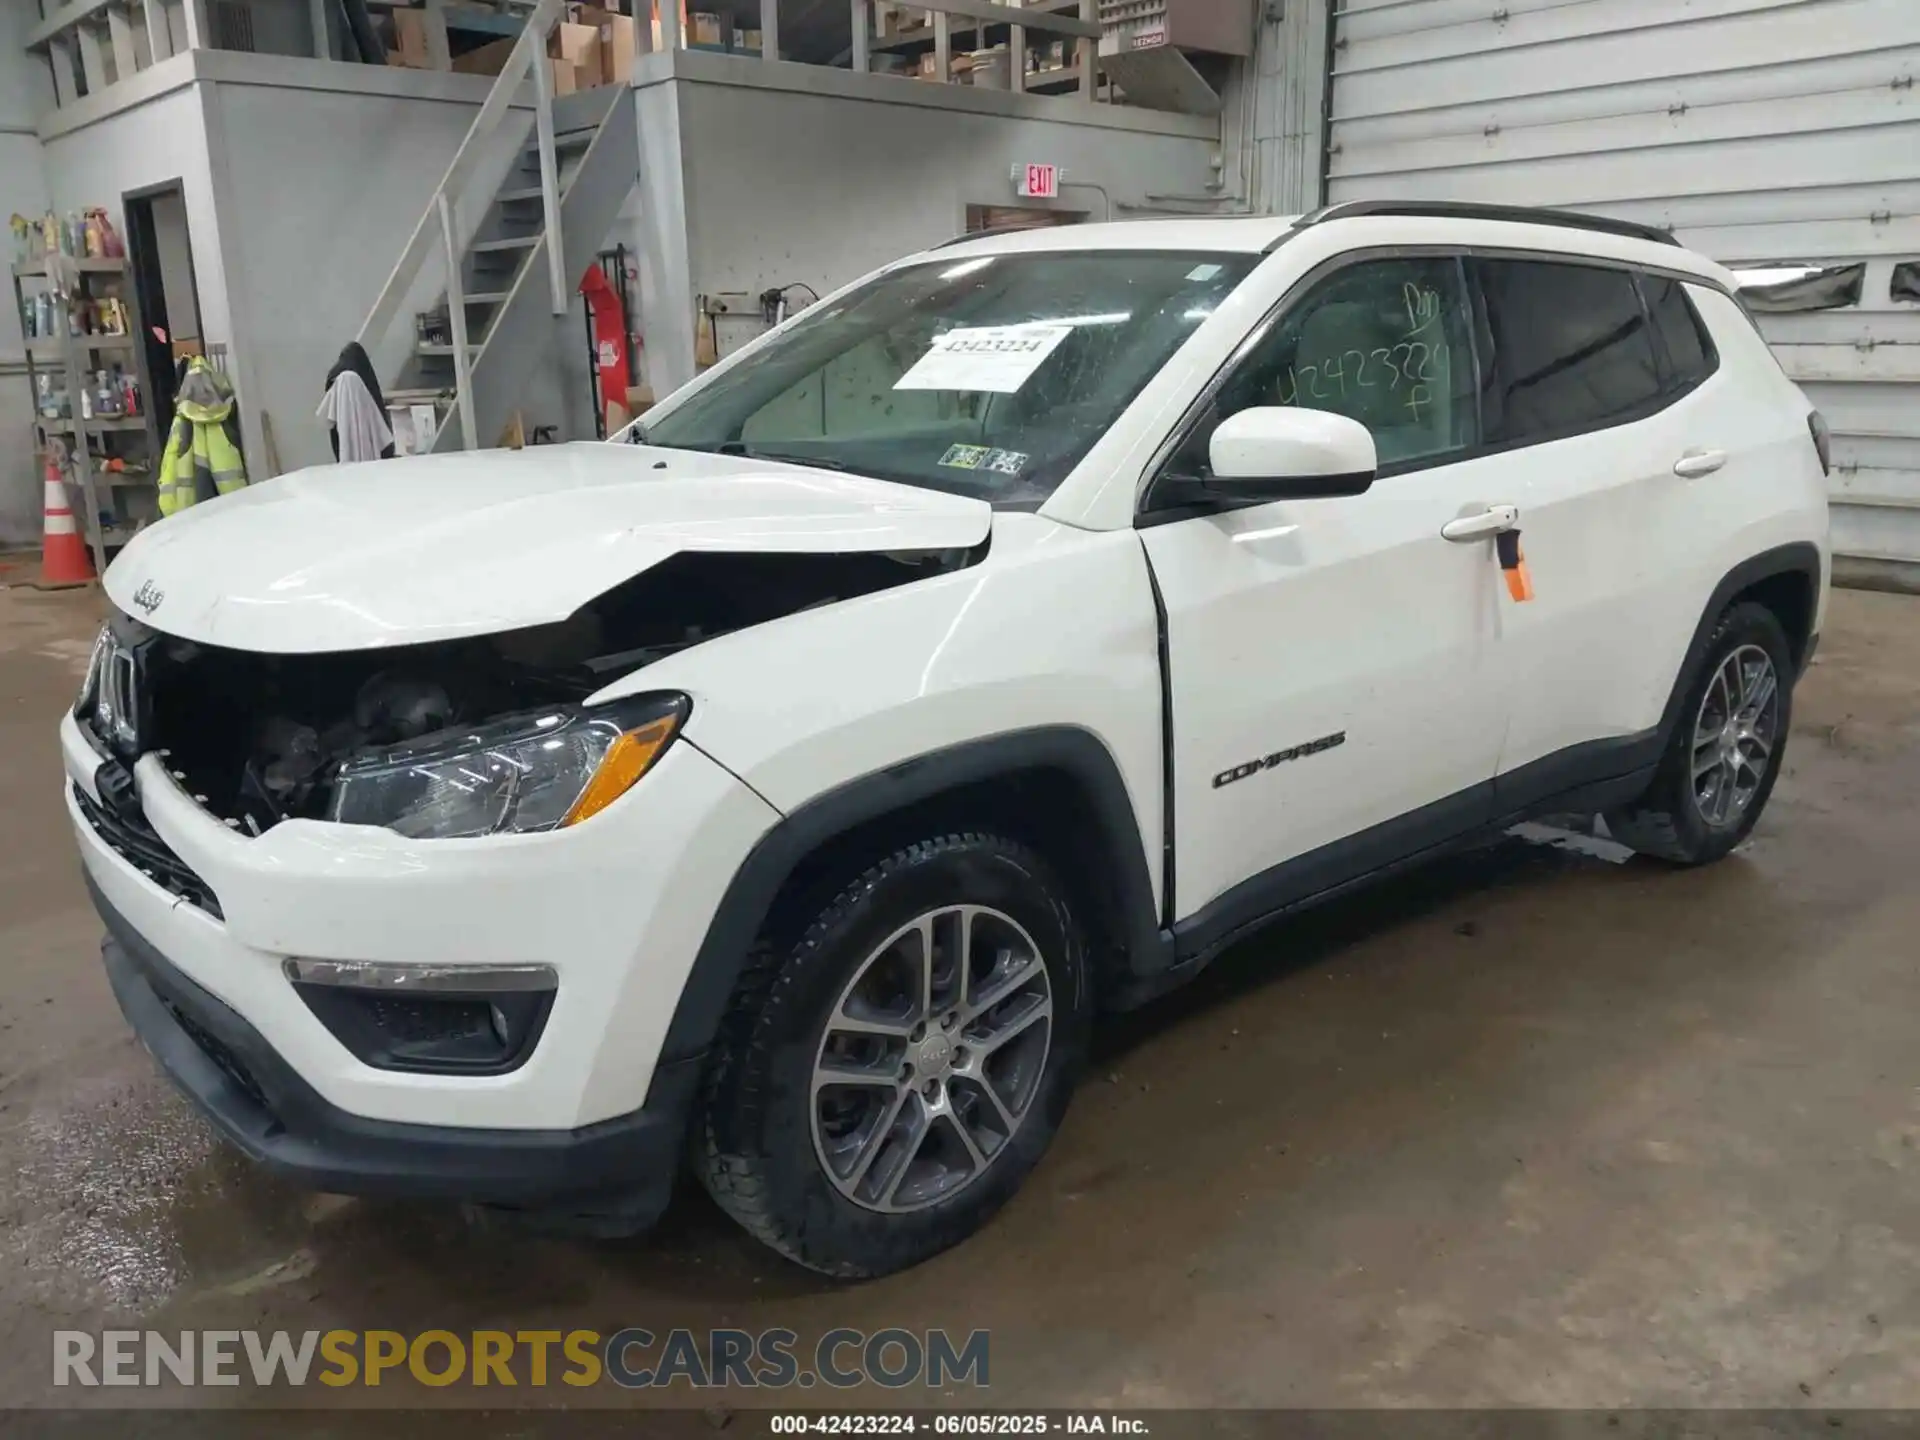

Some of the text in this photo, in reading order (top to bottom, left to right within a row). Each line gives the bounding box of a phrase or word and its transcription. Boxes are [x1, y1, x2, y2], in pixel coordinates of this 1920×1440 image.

[1029, 165, 1053, 194] EXIT
[944, 340, 1043, 352] 42423224
[1277, 342, 1450, 408] 42423224
[133, 579, 165, 616] Jeep
[1212, 730, 1346, 789] COMPASS
